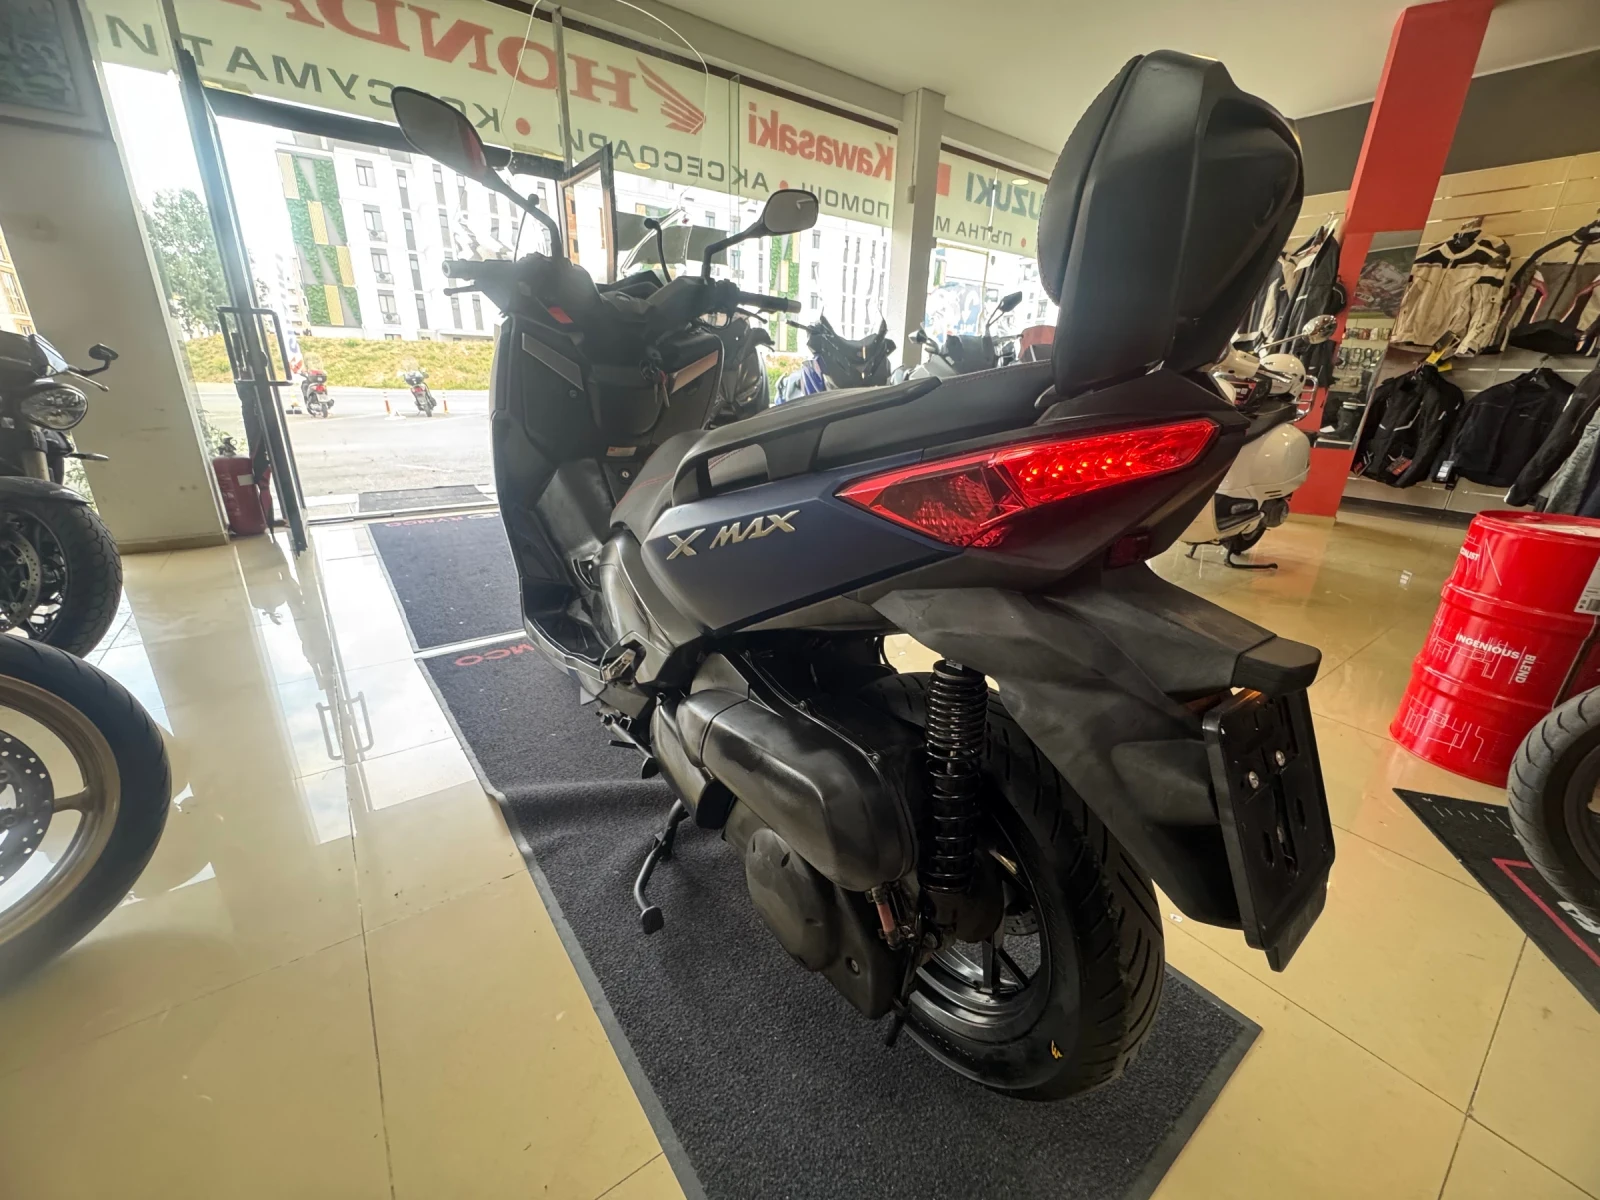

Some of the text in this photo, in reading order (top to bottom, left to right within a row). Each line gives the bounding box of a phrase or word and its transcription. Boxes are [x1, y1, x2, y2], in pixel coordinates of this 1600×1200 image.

[666, 509, 801, 561] X MAX
[454, 643, 536, 667] MCO
[1455, 633, 1520, 660] INGENIOUS
[1515, 653, 1537, 684] BLEND
